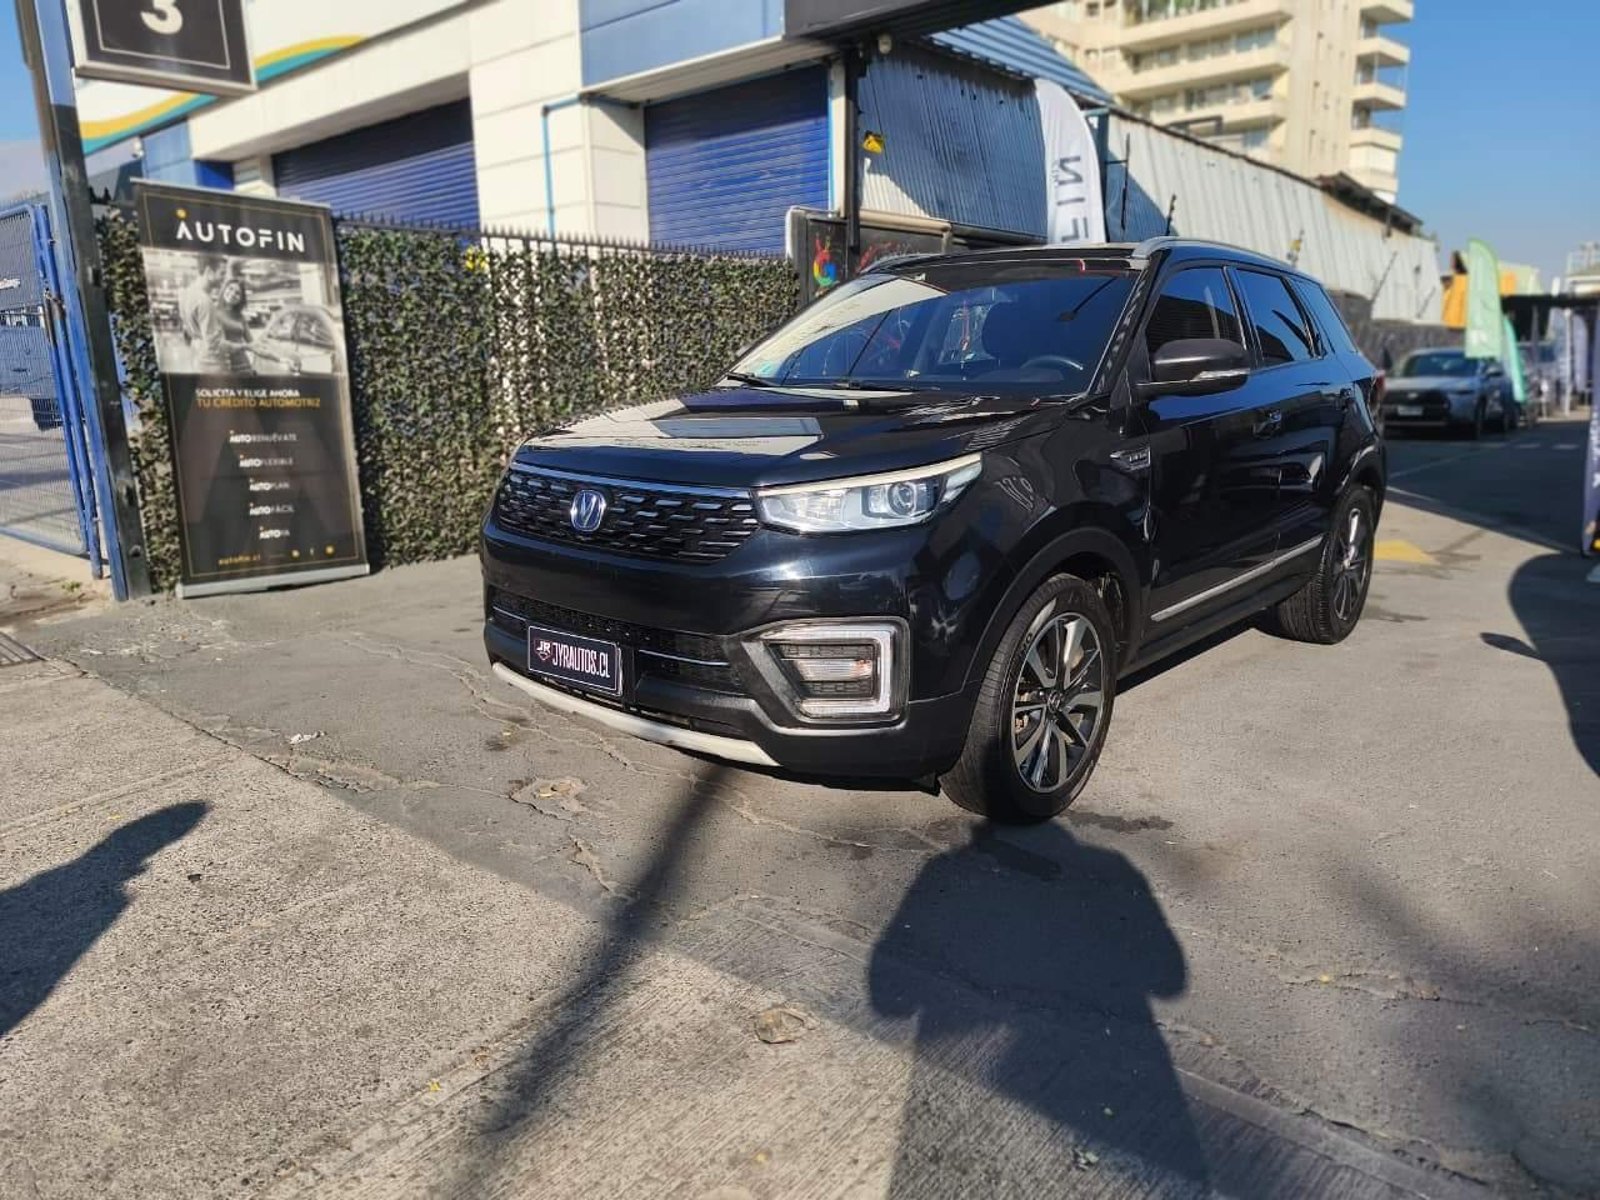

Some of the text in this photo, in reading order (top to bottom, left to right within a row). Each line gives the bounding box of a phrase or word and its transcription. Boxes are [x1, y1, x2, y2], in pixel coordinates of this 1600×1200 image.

[176, 209, 305, 252] AUTOFIN
[195, 388, 236, 398] SOLICITA
[269, 389, 300, 398] AHORA
[198, 398, 211, 408] TU
[259, 398, 321, 408] AUTOMOTRIZ
[552, 642, 611, 679] JYRAUTOS.CL
